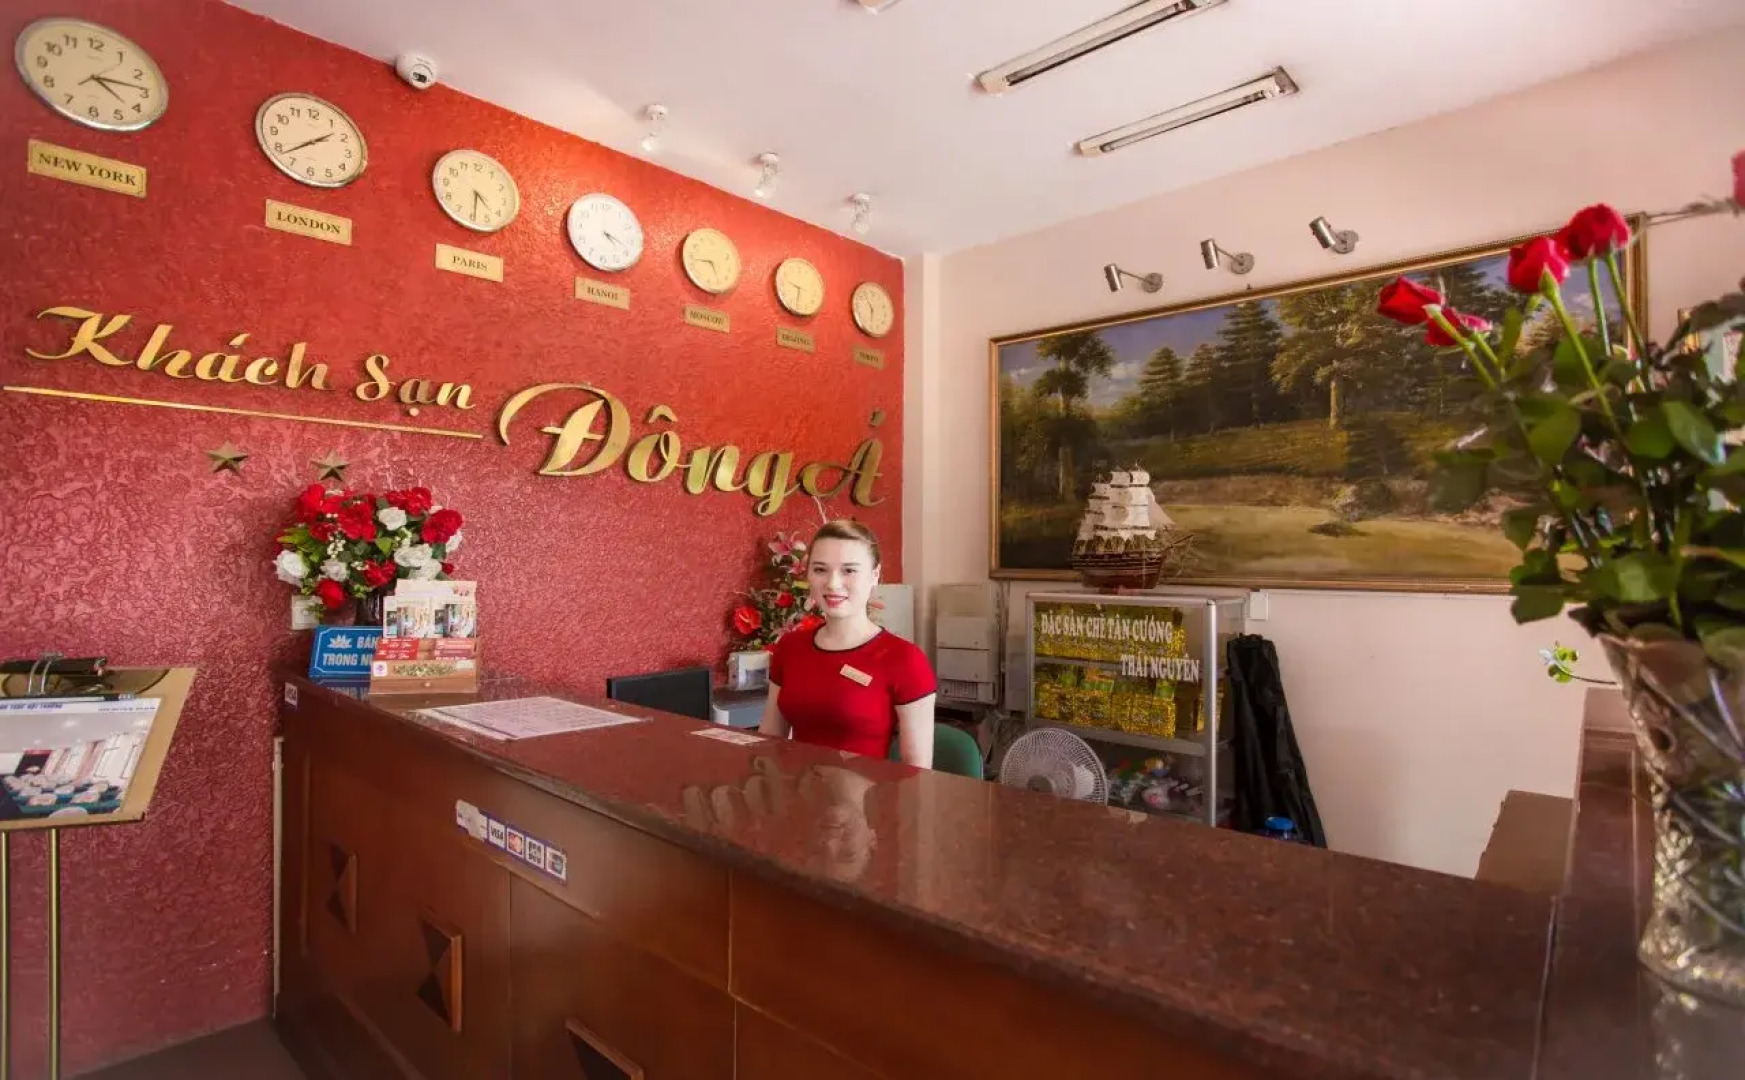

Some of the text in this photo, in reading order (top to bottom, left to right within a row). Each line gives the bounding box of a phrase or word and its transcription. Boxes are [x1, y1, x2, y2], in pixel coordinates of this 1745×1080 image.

[64, 34, 78, 49] 11
[87, 37, 105, 52] 12
[45, 41, 62, 56] 10
[37, 55, 48, 68] 9
[117, 51, 124, 64] 1
[133, 69, 143, 80] 2
[43, 75, 55, 88] 8
[64, 93, 74, 105] 7
[140, 88, 149, 99] 3
[88, 105, 99, 118] 6
[131, 103, 141, 113] 4
[290, 107, 300, 118] 11
[307, 108, 320, 120] 12
[113, 109, 124, 120] 5
[276, 114, 289, 125] 10
[329, 119, 334, 128] 1
[270, 126, 278, 135] 9
[340, 133, 348, 143] 2
[274, 142, 283, 152] 8
[344, 149, 352, 159] 3
[289, 156, 297, 166] 7
[338, 162, 346, 171] 4
[39, 152, 136, 186] NEW YORK
[306, 166, 315, 176] 6
[325, 168, 333, 178] 5
[276, 210, 341, 234] LONDON
[453, 255, 488, 271] PARIS
[586, 286, 619, 301] HANOI
[25, 306, 477, 417] Khách Sạn
[499, 382, 801, 517] Đông
[1106, 613, 1130, 640] TÂN
[323, 653, 358, 666] TRONG
[1150, 653, 1200, 684] NGUYÊN
[491, 826, 504, 841] VISA
